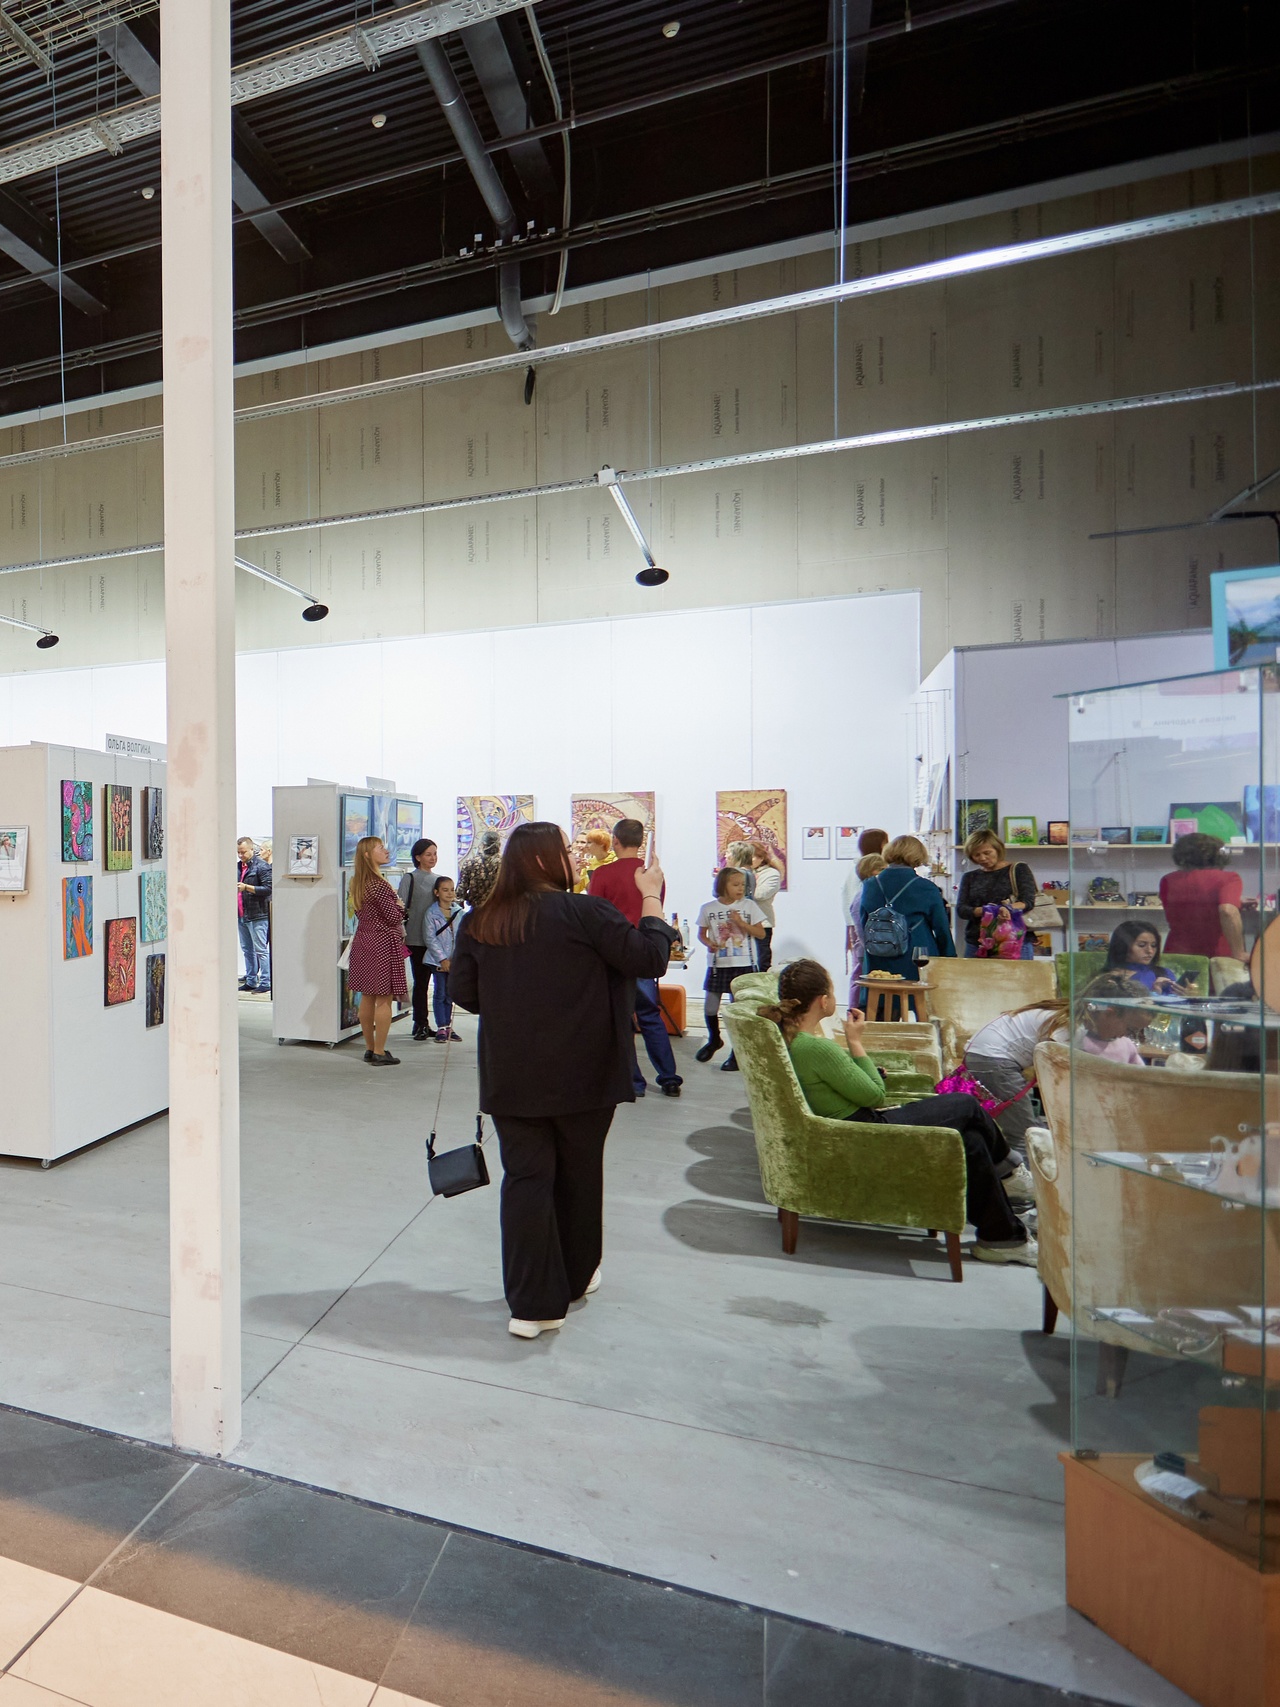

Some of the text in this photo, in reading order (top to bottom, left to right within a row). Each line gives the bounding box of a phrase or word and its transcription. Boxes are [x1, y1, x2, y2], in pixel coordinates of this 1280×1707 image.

[733, 492, 741, 532] AQUAPANEL
[856, 484, 865, 527] AQUAPANEL
[602, 517, 610, 556] AQUAPANEL
[1014, 604, 1023, 642] QUAPANEL
[107, 738, 152, 755] ОЛЬГА ВОЛГИНА
[708, 908, 749, 920] REL
